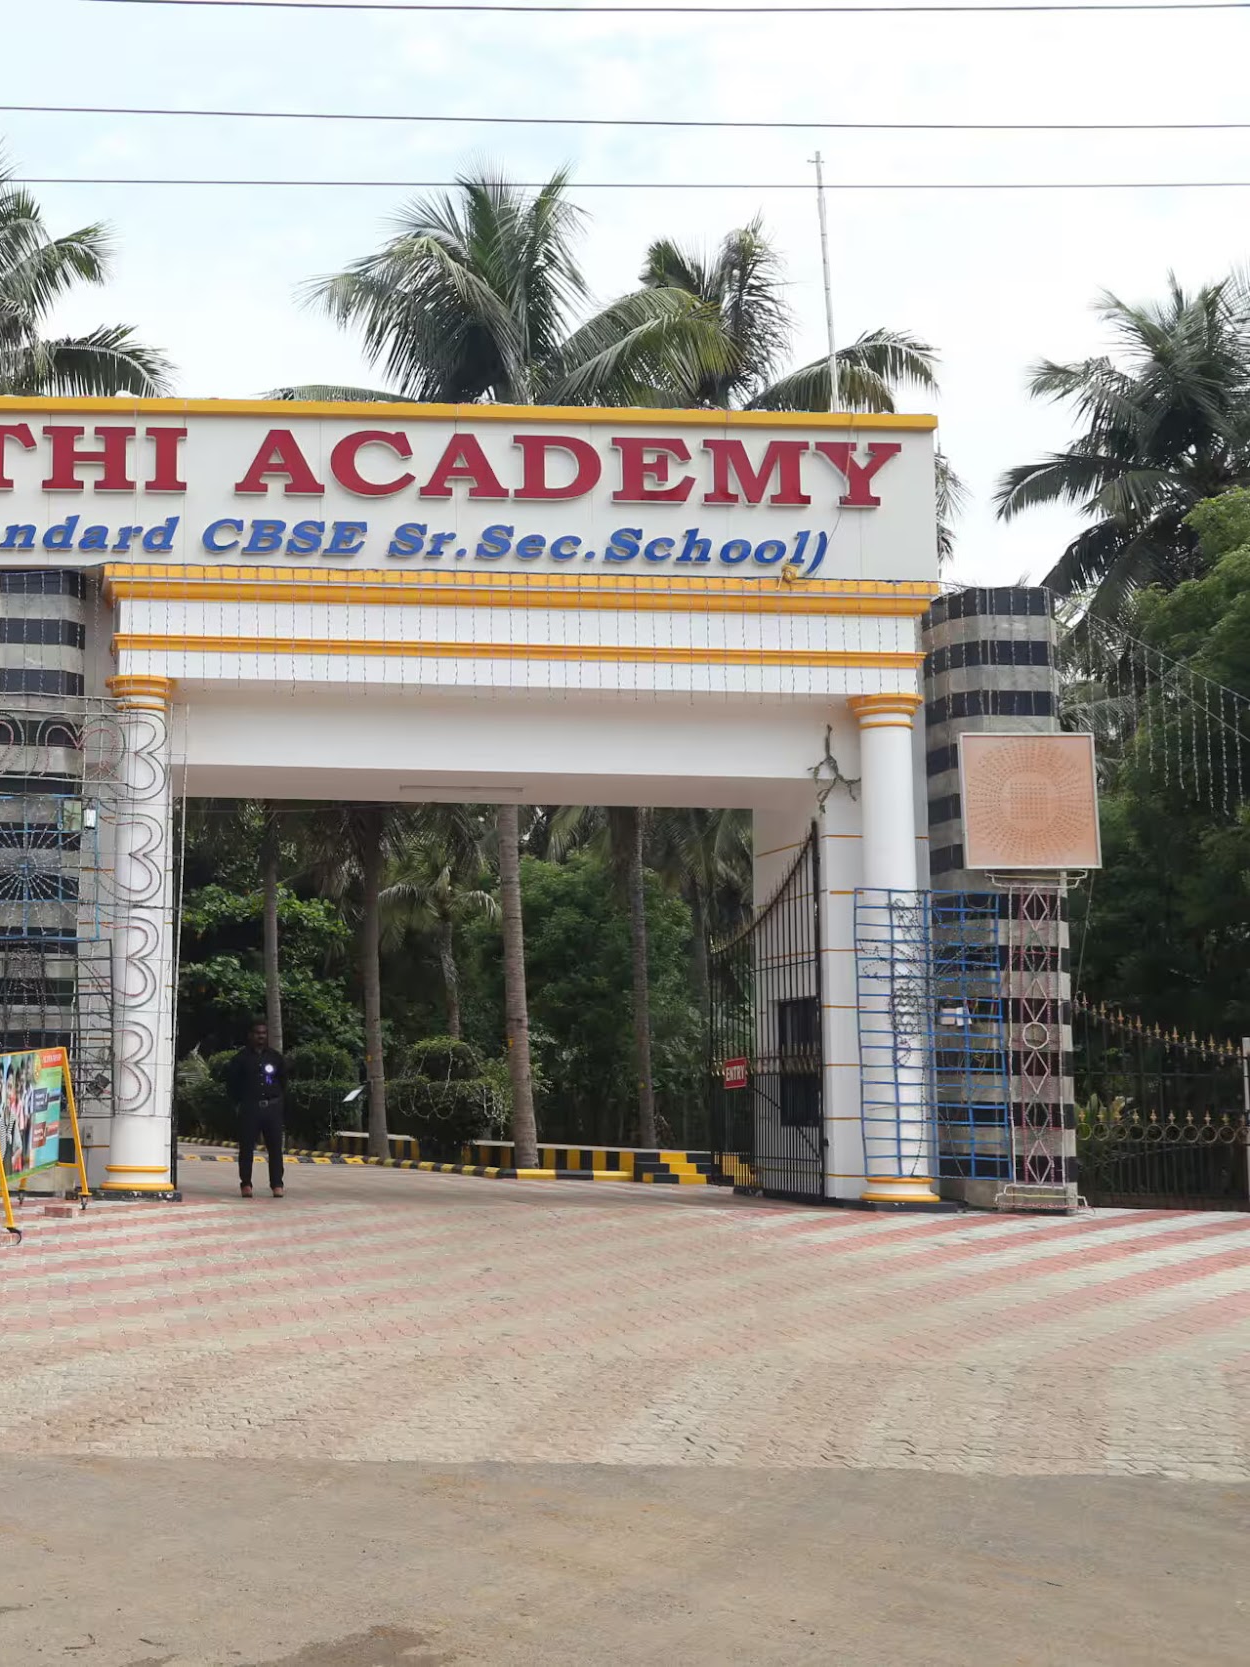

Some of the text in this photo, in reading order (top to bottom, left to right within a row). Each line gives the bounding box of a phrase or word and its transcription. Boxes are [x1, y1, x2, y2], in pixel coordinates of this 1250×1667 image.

[234, 429, 902, 507] ACADEMY
[201, 518, 368, 556] CBSE
[725, 1065, 745, 1082] ENTRY
